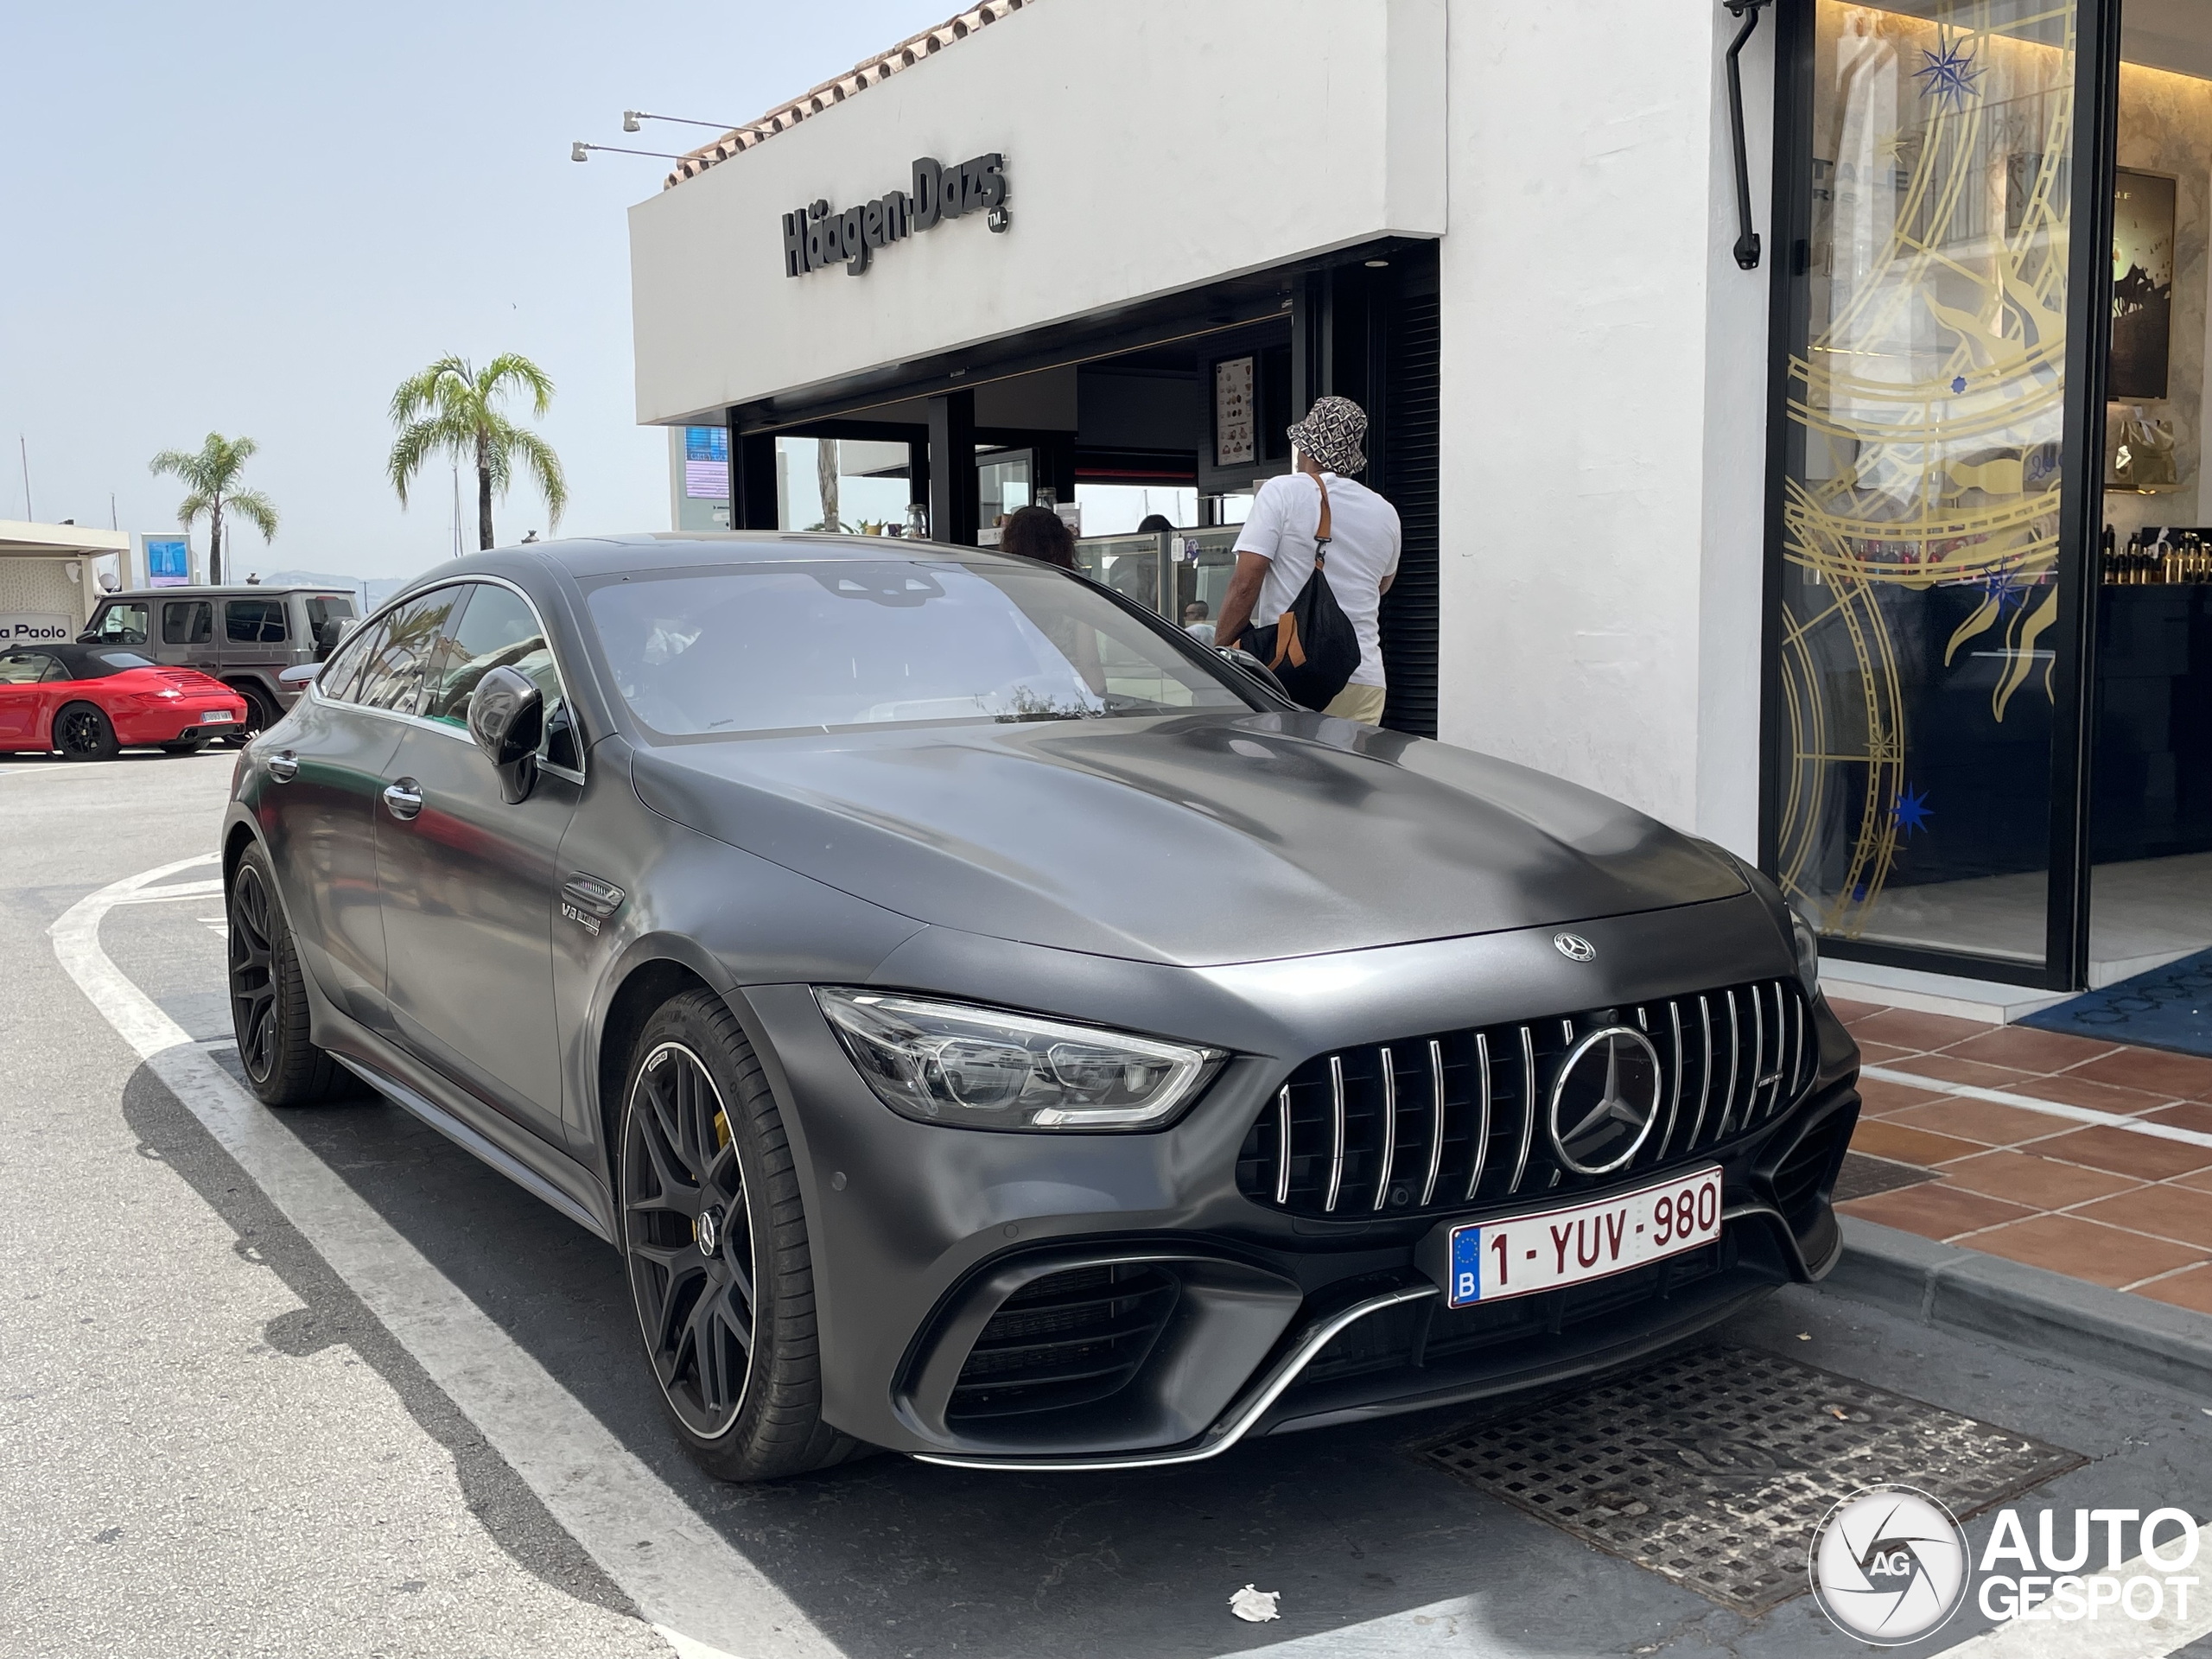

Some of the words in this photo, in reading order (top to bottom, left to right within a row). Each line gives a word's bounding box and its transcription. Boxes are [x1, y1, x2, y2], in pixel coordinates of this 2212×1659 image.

[781, 153, 1007, 278] Häagen-Dazs
[15, 624, 67, 639] Paolo
[562, 902, 578, 920] V8
[1459, 1272, 1476, 1297] B
